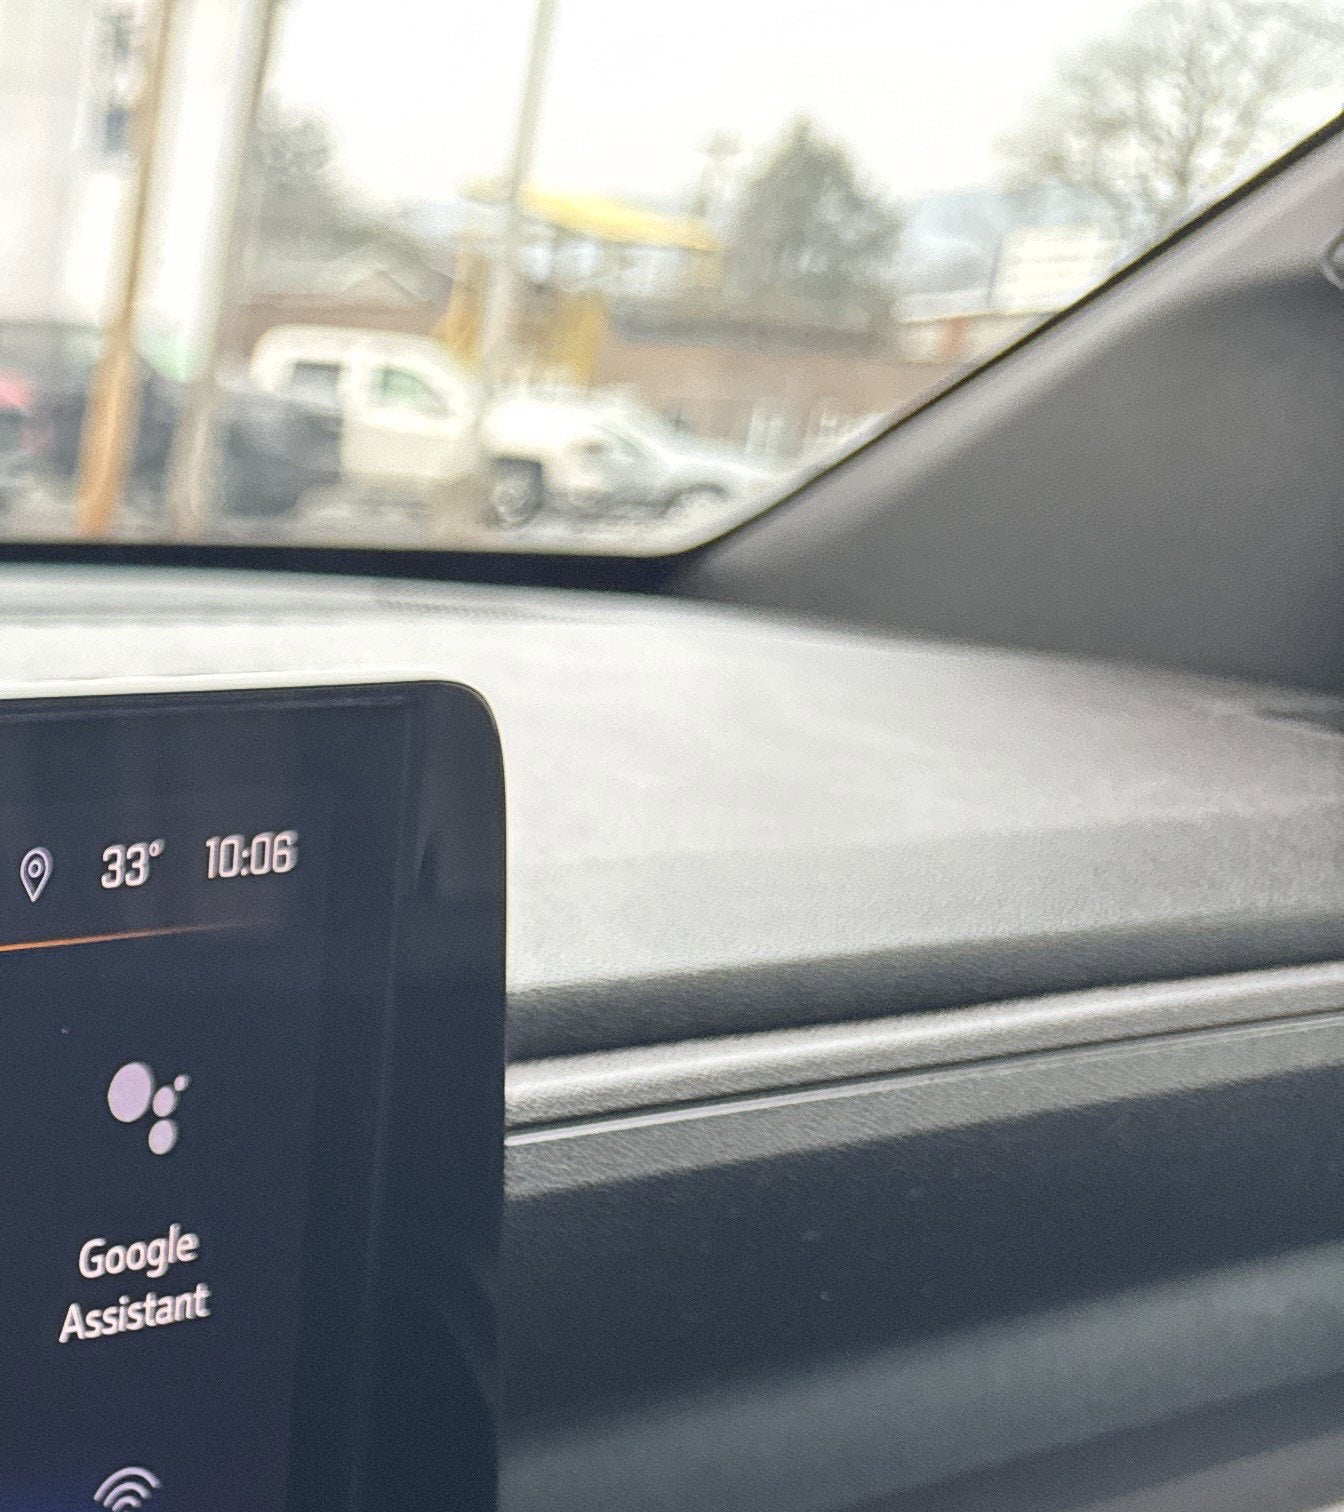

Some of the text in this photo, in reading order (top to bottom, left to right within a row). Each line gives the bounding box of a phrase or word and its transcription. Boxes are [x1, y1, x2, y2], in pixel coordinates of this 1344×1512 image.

[205, 830, 297, 879] 10:06
[78, 1223, 199, 1279] Google
[58, 1283, 210, 1344] Assistant
